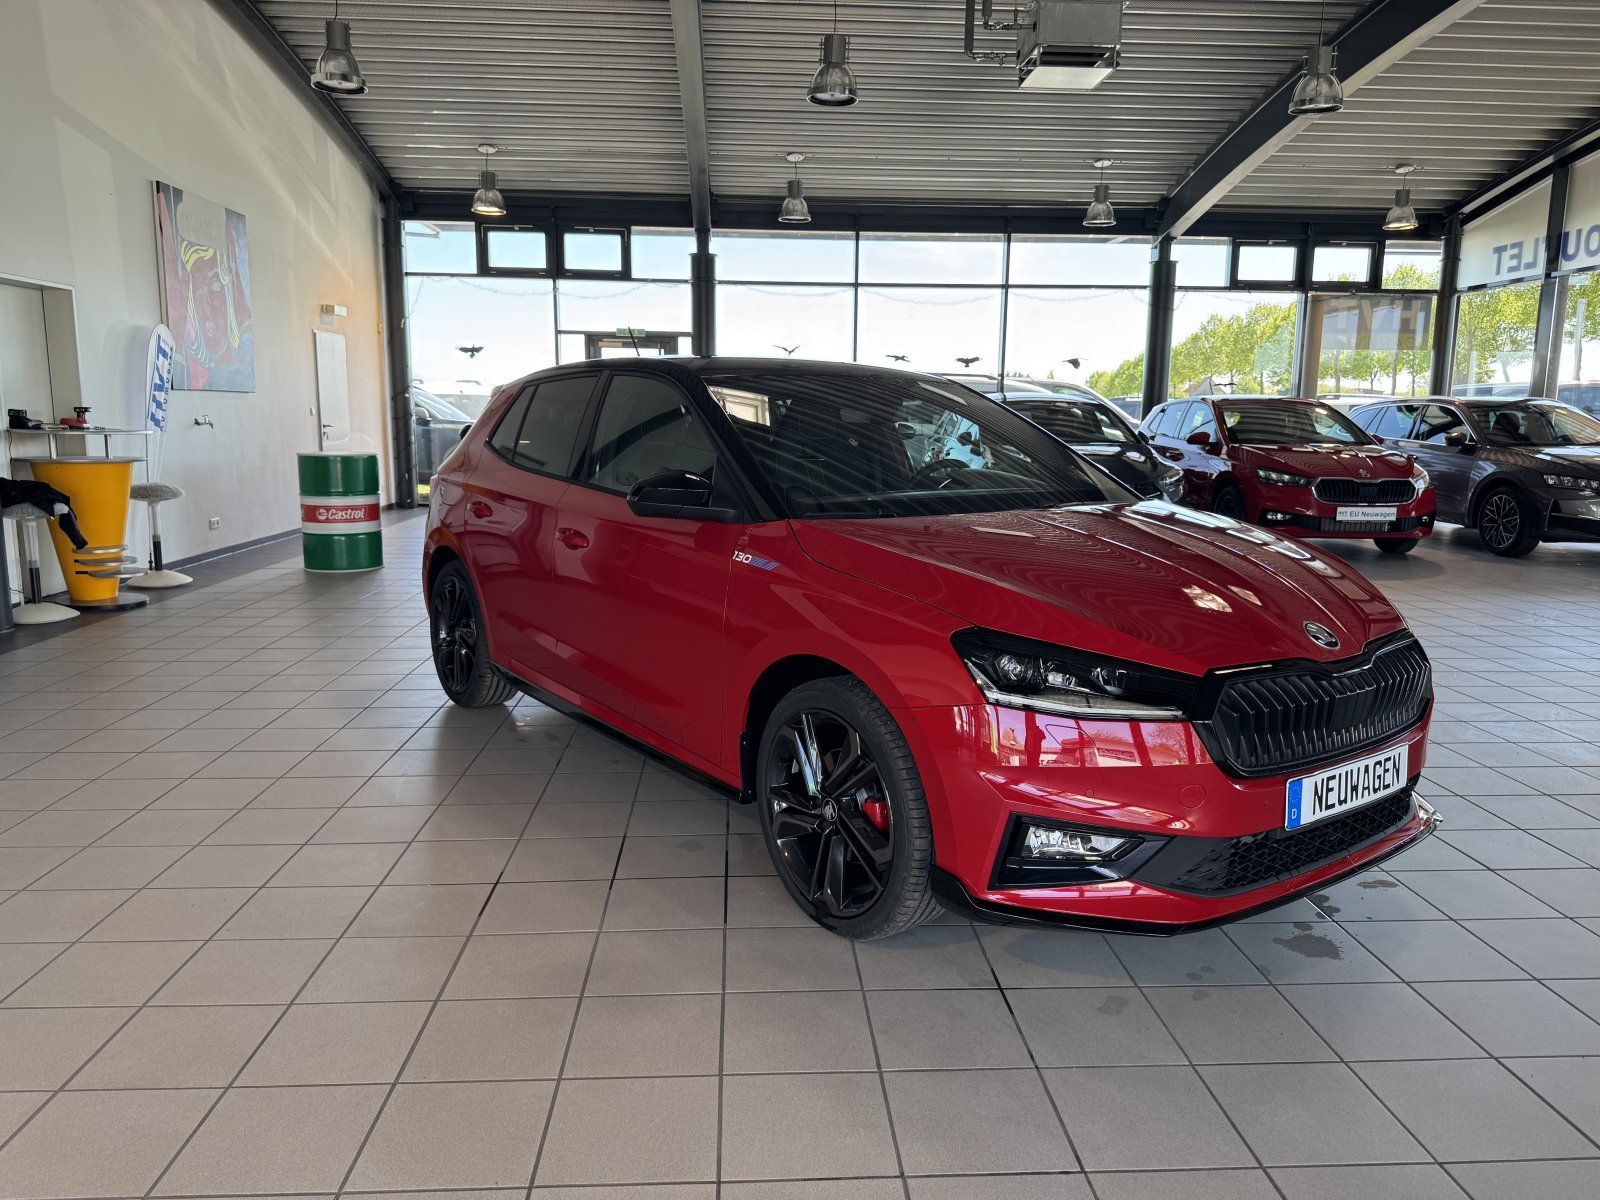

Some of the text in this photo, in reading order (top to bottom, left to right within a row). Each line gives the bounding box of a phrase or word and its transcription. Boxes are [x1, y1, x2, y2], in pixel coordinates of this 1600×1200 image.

[150, 334, 168, 428] HVT
[328, 508, 365, 520] Castrol
[732, 551, 752, 564] 130
[1313, 752, 1400, 815] NEUWAGEN
[1292, 809, 1297, 818] D
